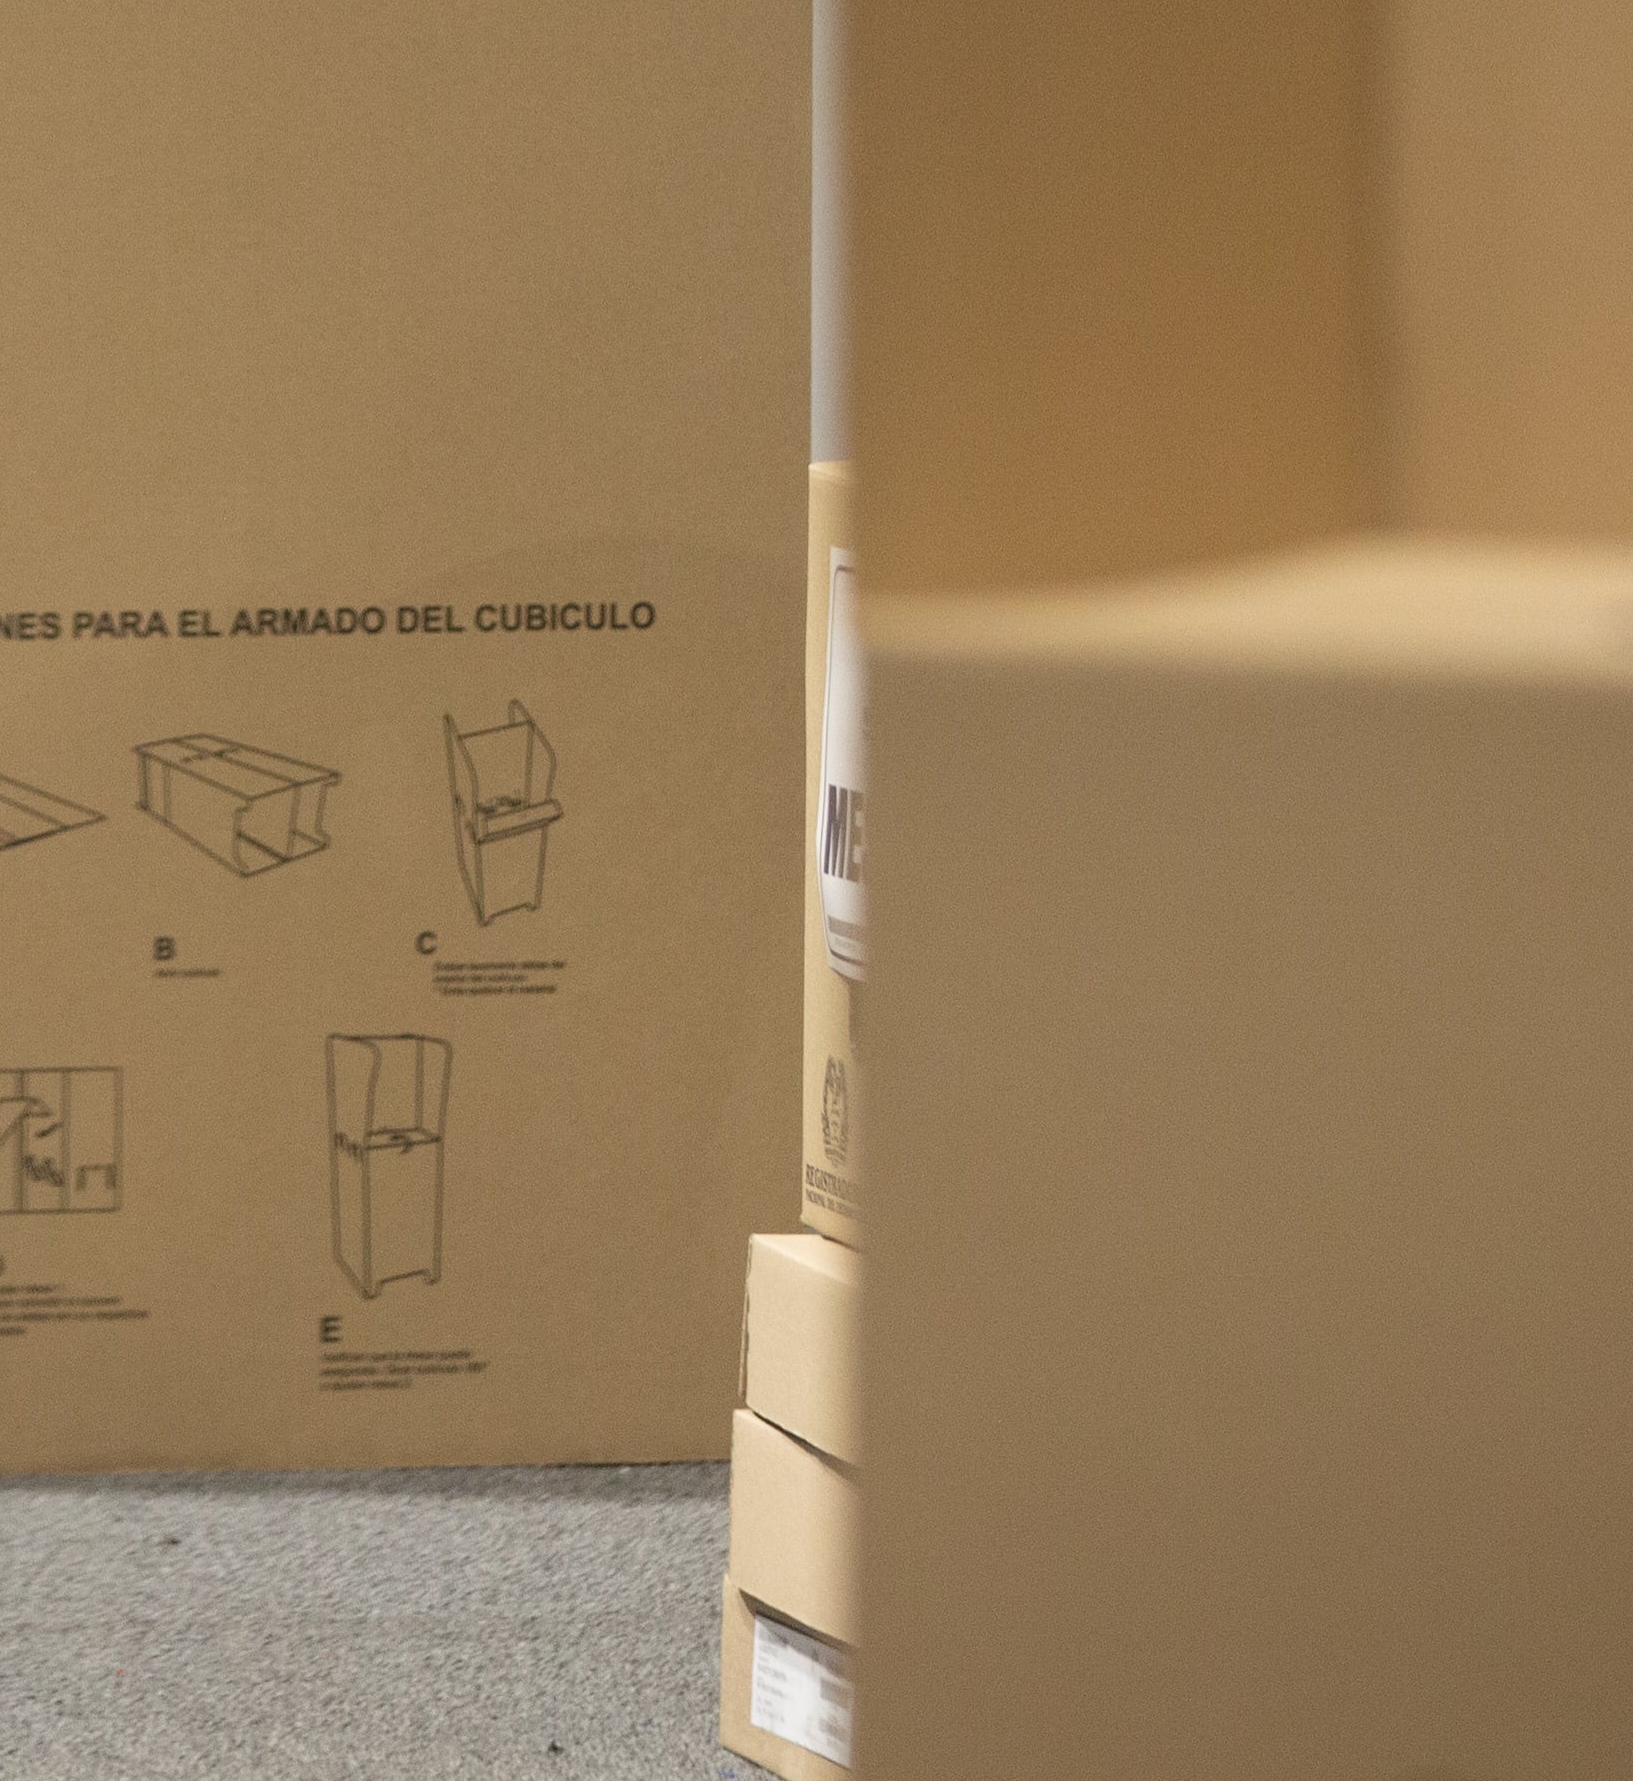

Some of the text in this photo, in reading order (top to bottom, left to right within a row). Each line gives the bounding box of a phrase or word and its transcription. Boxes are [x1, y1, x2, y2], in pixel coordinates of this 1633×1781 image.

[71, 610, 169, 639] PARA
[178, 609, 221, 639] EL
[229, 606, 386, 636] ARMADO
[396, 605, 465, 633] DEL
[473, 600, 656, 632] CUBICULO
[824, 784, 867, 884] ME
[153, 936, 176, 961] B
[415, 931, 437, 955] C
[320, 1315, 341, 1342] E
